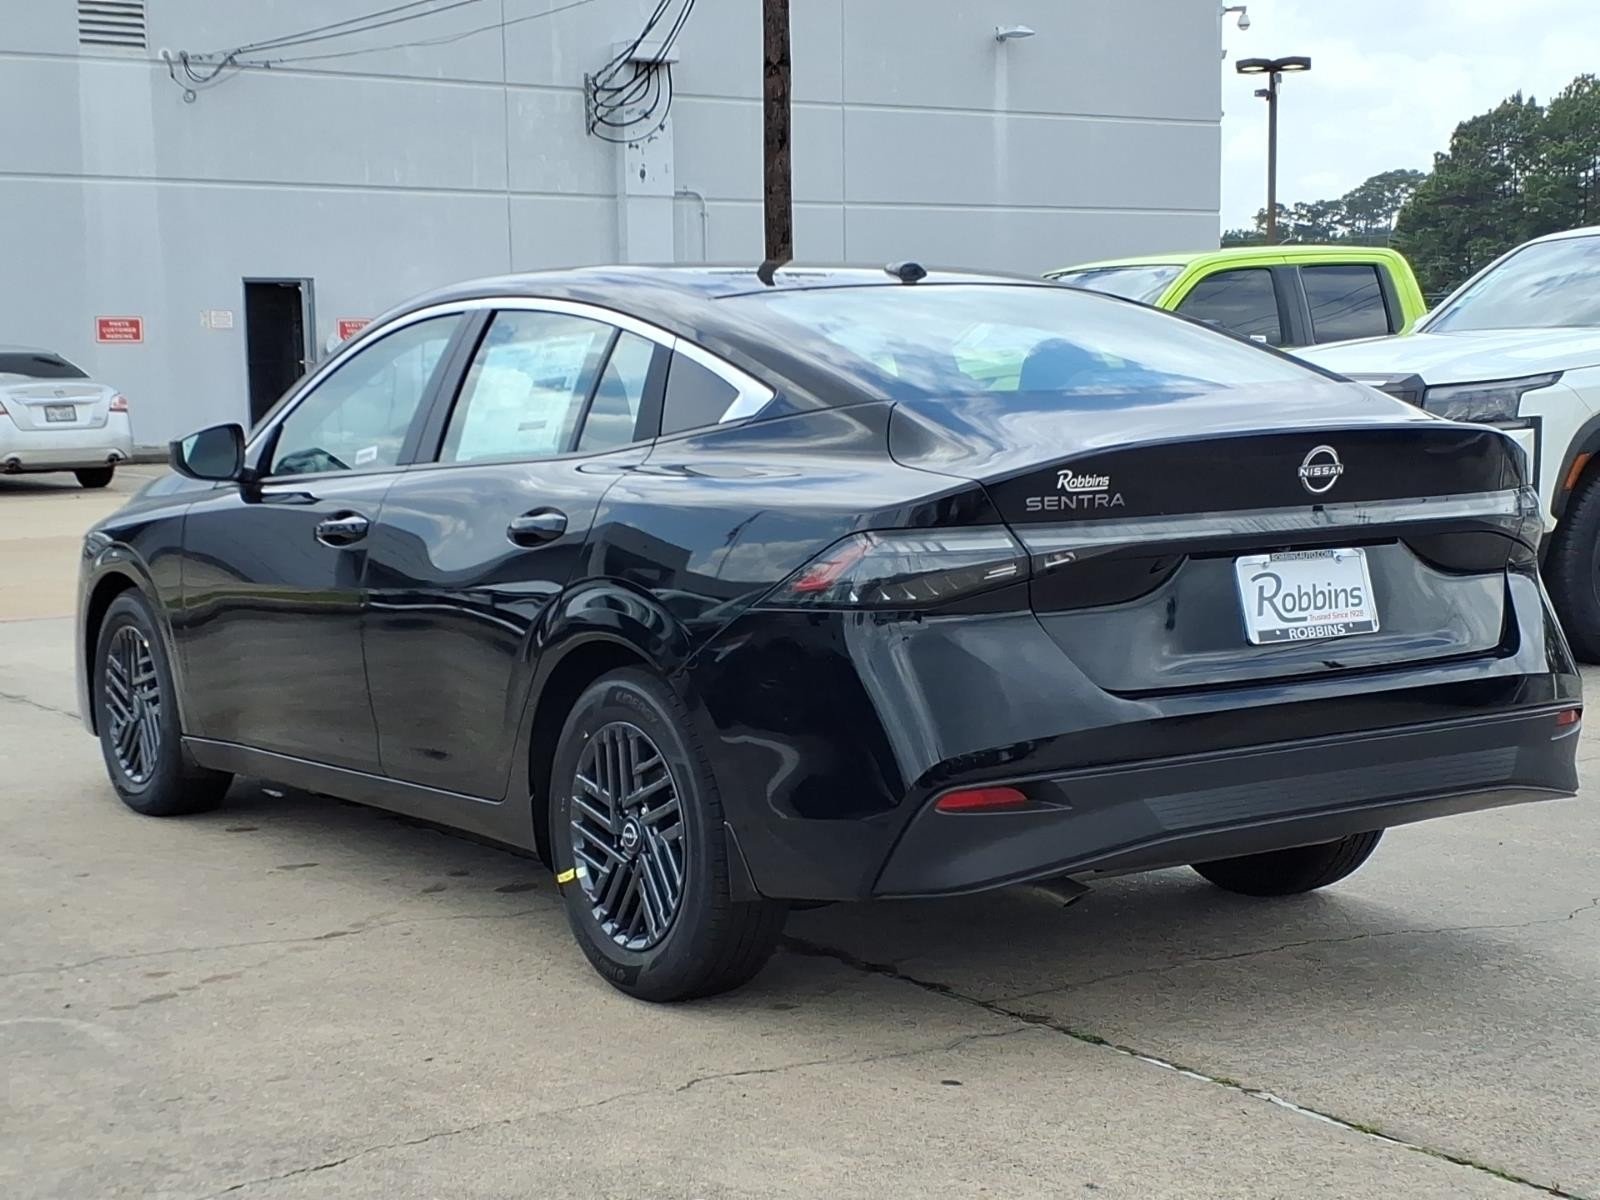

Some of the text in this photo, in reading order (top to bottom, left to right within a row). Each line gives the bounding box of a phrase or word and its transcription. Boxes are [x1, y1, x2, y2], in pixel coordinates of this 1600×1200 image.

[1299, 466, 1343, 477] NISSAN
[1057, 469, 1110, 492] Robbins
[1026, 493, 1125, 511] SENTRA
[1250, 572, 1363, 623] Robbins
[1309, 612, 1331, 621] Trusted
[1331, 611, 1348, 619] Since
[1288, 623, 1346, 640] ROBBINS
